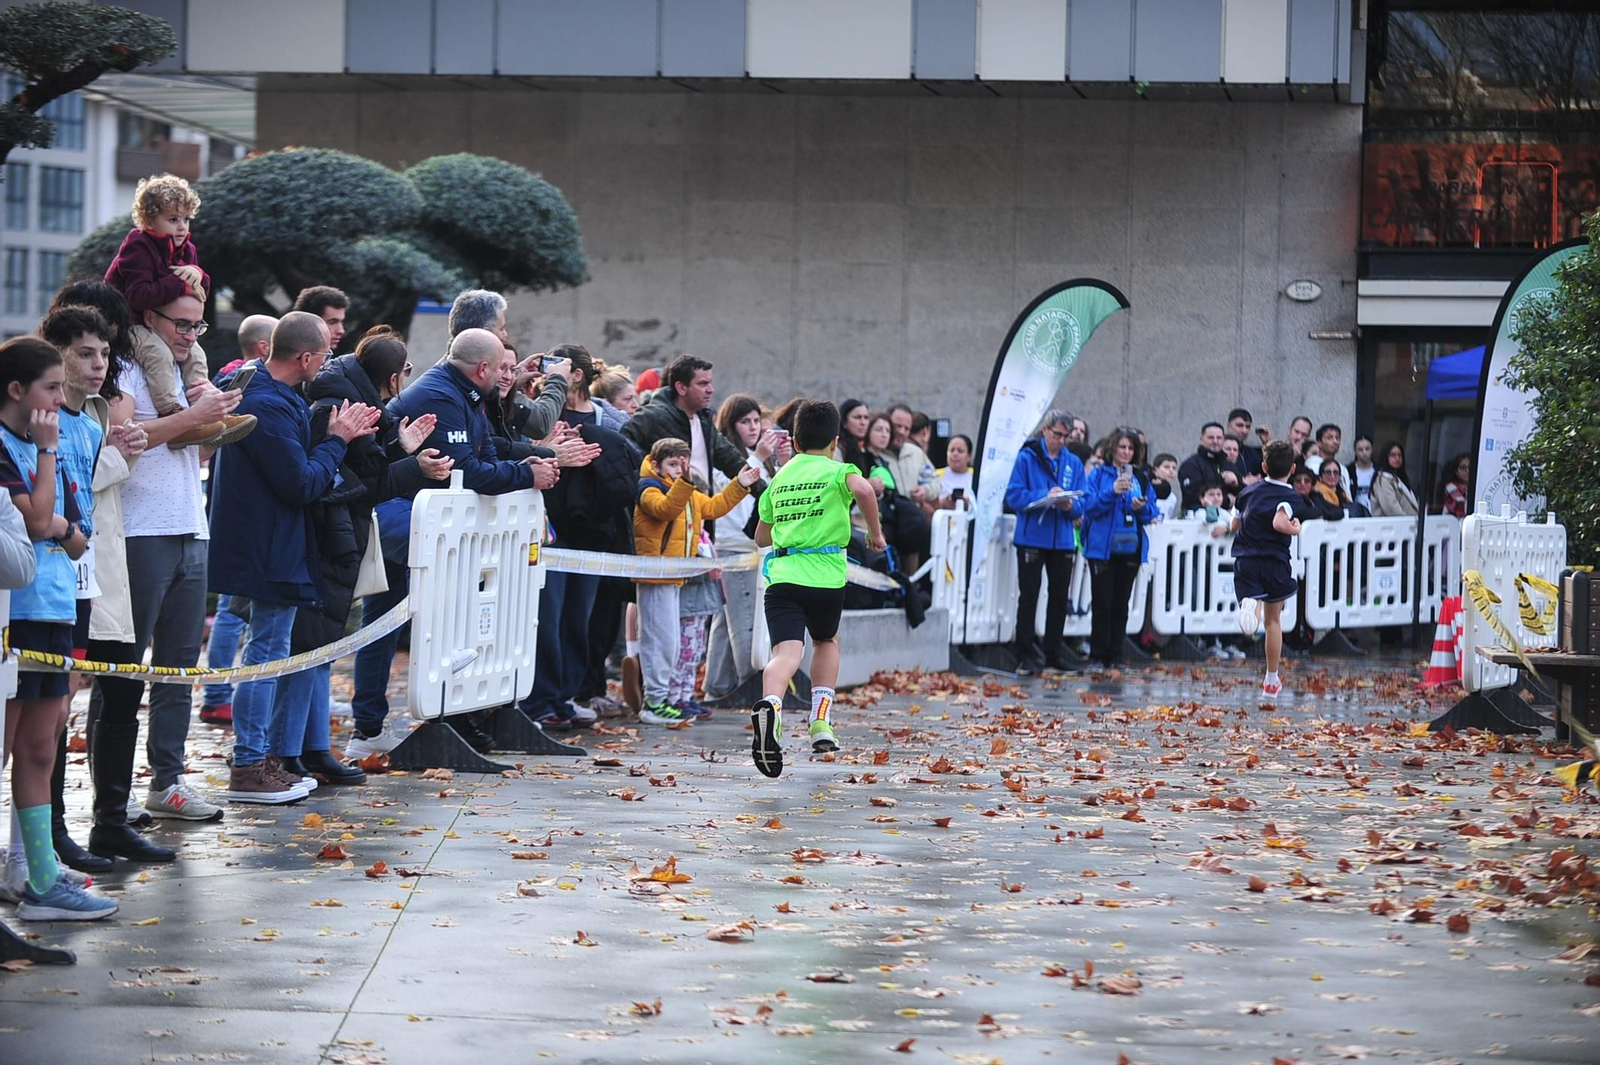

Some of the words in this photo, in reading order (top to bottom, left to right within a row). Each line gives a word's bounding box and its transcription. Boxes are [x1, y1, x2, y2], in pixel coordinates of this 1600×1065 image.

[447, 431, 468, 443] HH
[775, 495, 821, 509] ESCUELA
[167, 792, 188, 810] N
